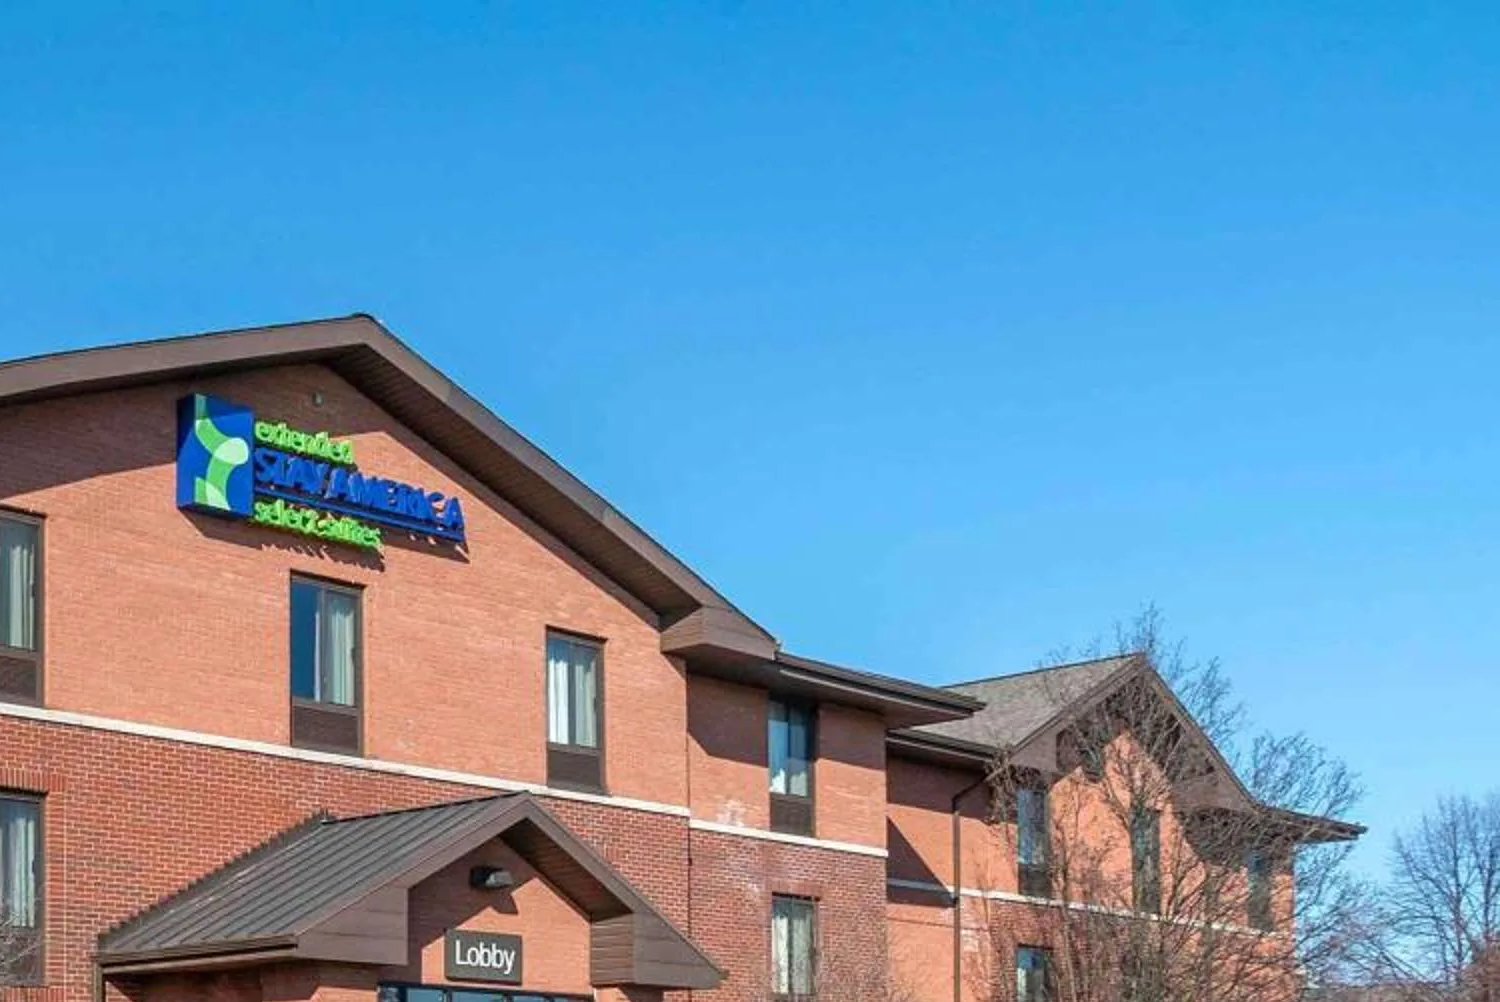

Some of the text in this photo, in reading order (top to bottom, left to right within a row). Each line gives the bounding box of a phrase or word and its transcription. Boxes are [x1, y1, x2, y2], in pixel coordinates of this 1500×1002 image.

[255, 422, 352, 464] extended
[255, 447, 463, 528] STAY AMERICA
[255, 499, 319, 535] select
[455, 940, 515, 974] Lobby
